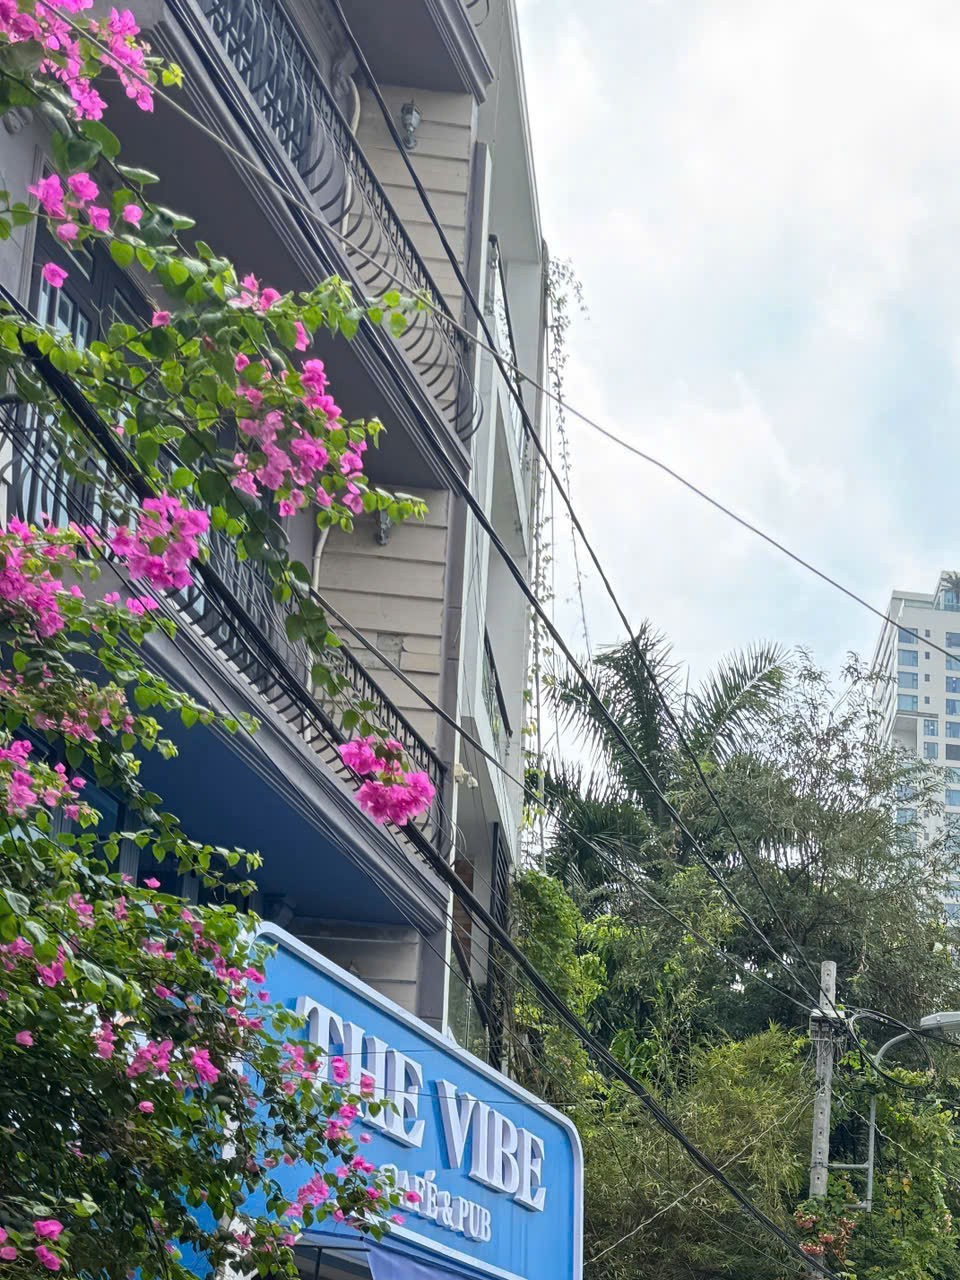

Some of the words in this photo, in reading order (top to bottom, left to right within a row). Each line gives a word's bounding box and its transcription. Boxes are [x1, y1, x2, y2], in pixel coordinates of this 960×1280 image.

[296, 995, 426, 1148] THE
[435, 1079, 547, 1212] VIBE
[451, 1195, 492, 1243] PUB
